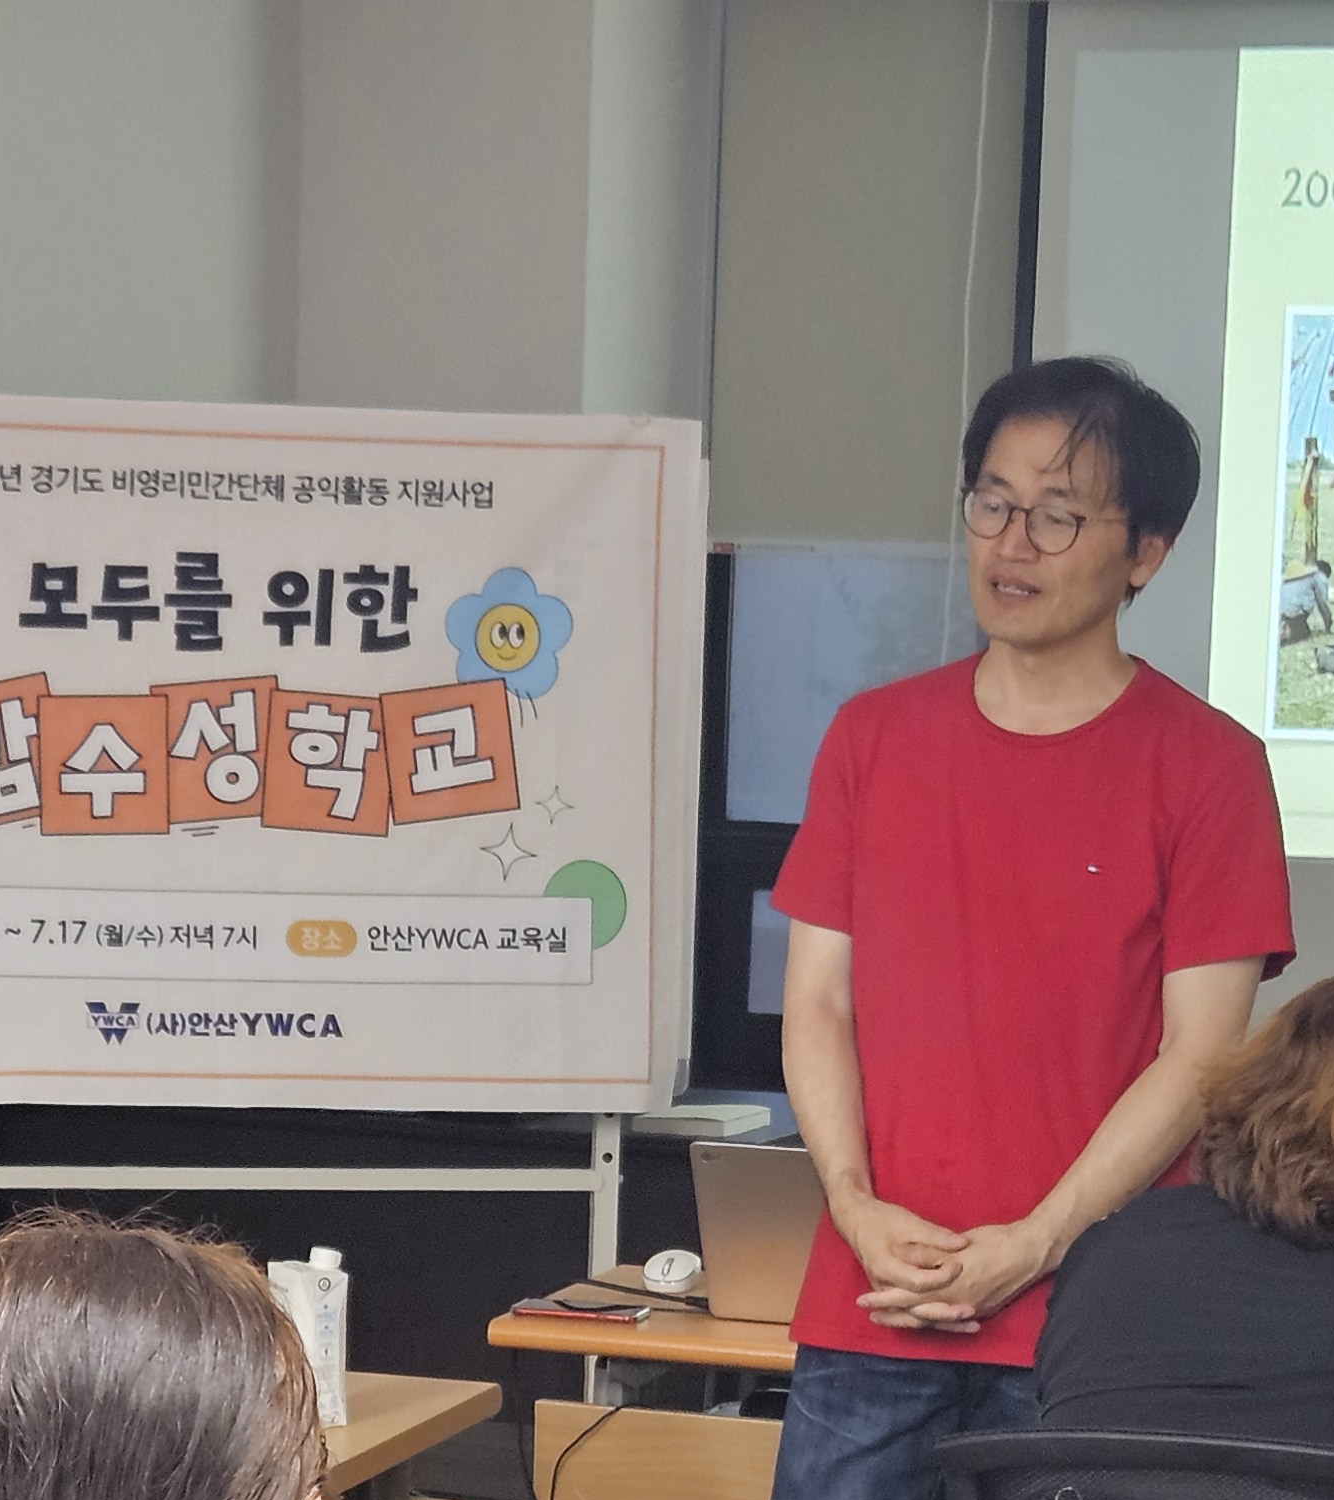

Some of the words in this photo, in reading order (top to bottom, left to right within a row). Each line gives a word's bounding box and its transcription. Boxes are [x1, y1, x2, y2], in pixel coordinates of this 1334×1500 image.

[30, 464, 105, 495] 경기도
[112, 468, 285, 503] 비영리민간단체
[292, 475, 390, 507] 공익활동
[397, 478, 495, 509] 지원사업
[18, 551, 233, 652] 모두를
[262, 564, 419, 653] 위한
[30, 919, 88, 945] 7.17
[95, 923, 164, 949] (월/수)
[169, 923, 214, 950] 저녁
[222, 925, 258, 950] 7시
[367, 925, 489, 952] 안산YWCA
[496, 926, 568, 953] 교육실
